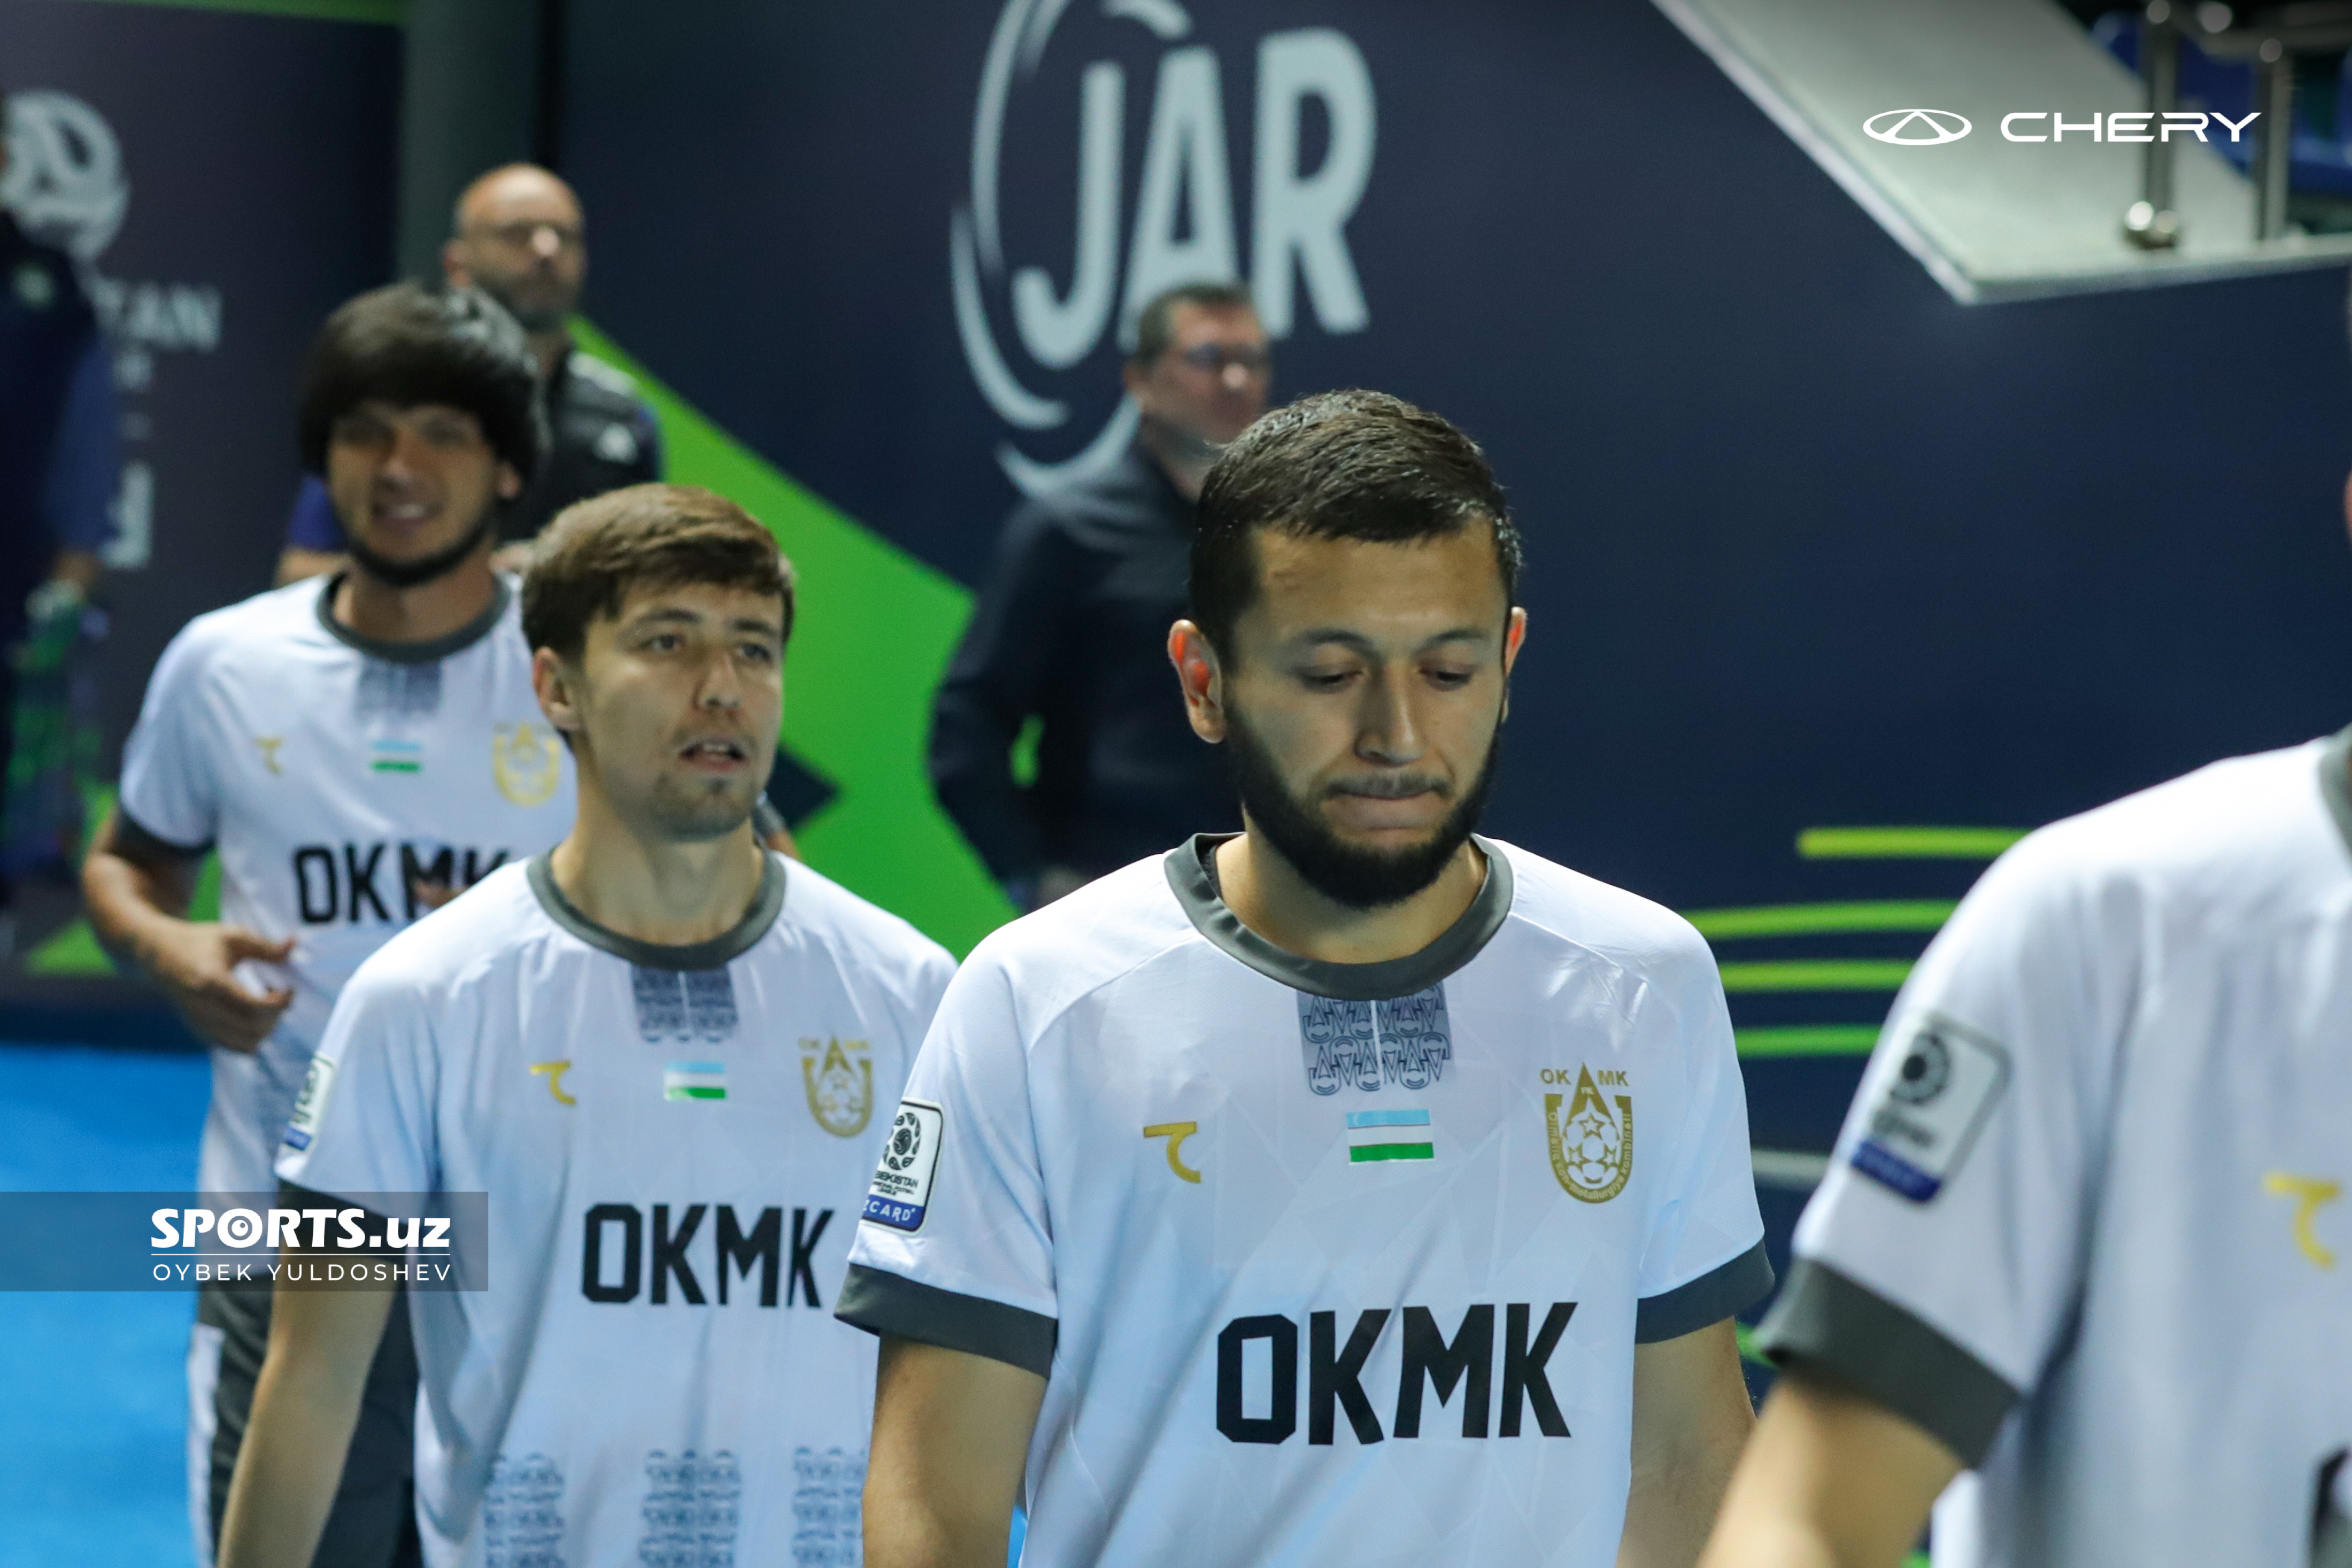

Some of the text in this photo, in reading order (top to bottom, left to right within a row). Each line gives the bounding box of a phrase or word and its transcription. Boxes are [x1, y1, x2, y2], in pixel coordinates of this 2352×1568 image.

[1009, 26, 1378, 370] JAR
[1540, 1069, 1630, 1087] OK MK
[582, 1202, 835, 1308] OKMK
[1216, 1301, 1579, 1446] OKMK
